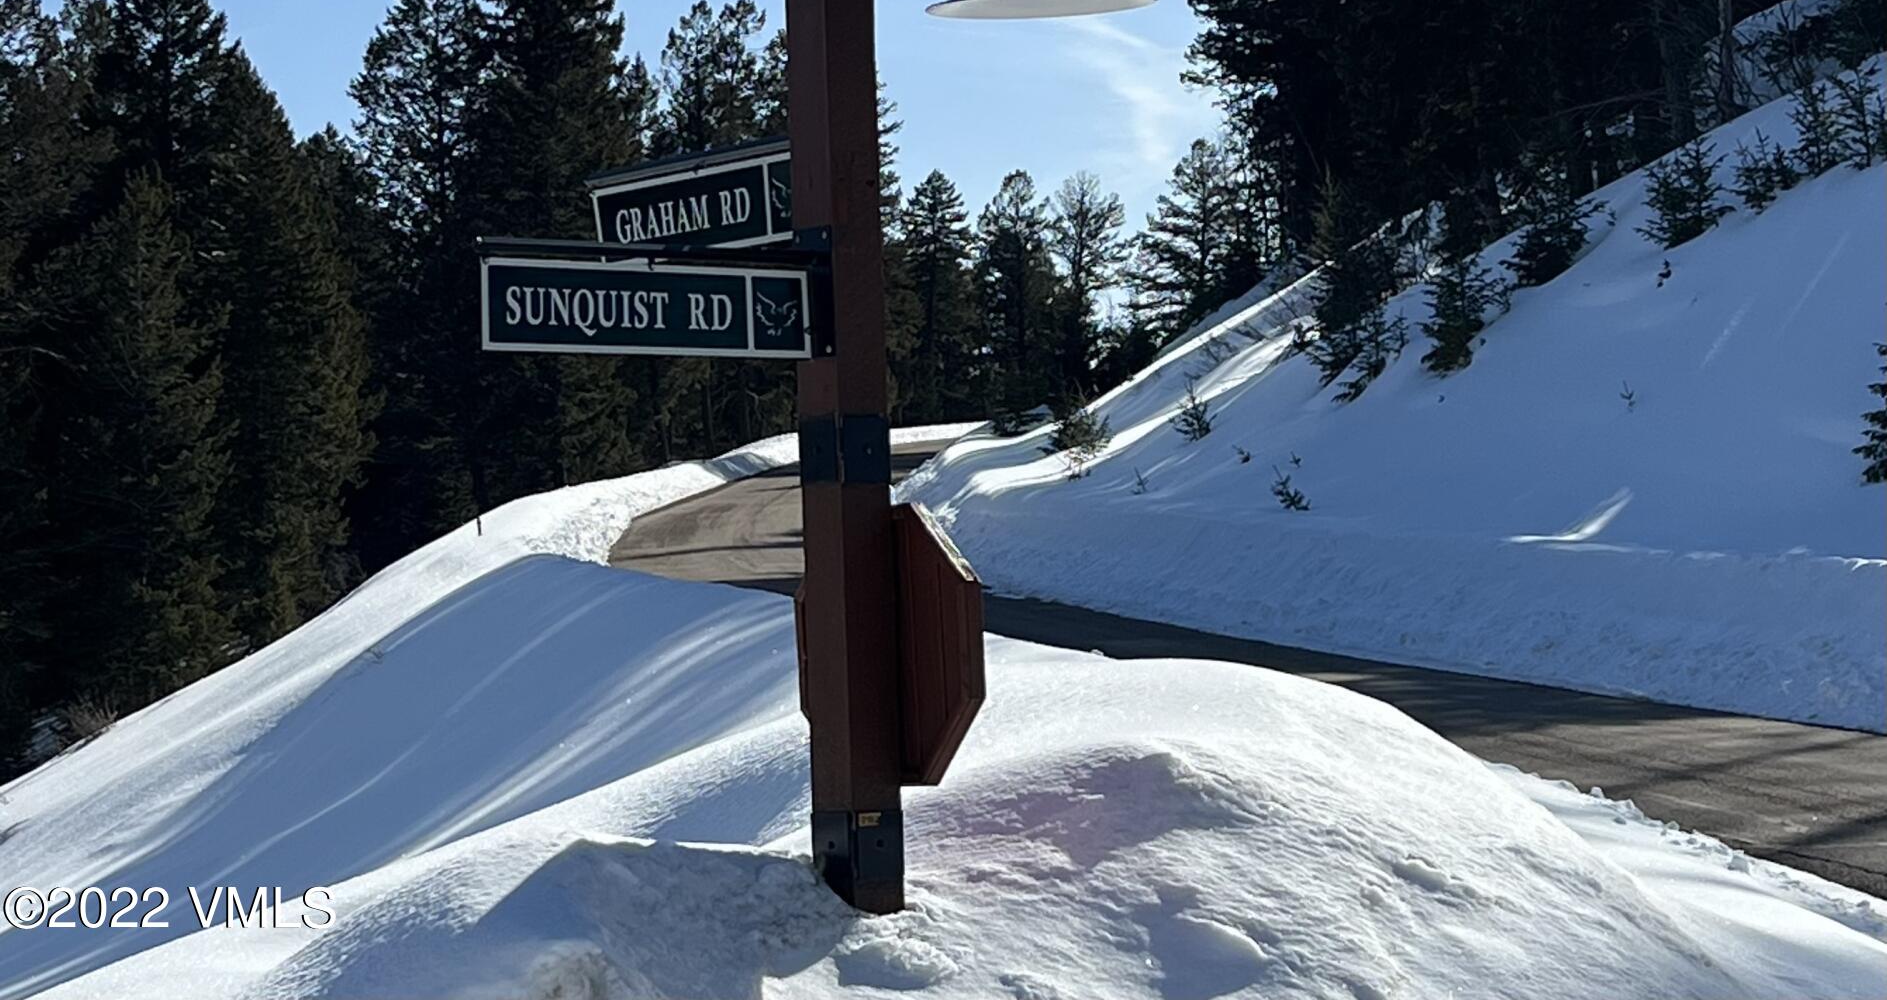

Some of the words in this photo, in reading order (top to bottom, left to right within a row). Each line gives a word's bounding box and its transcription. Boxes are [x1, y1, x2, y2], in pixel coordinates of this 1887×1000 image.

[615, 194, 710, 245] GRAHAM
[719, 187, 752, 226] RD
[505, 286, 669, 336] SUNQUIST
[688, 293, 733, 331] RD
